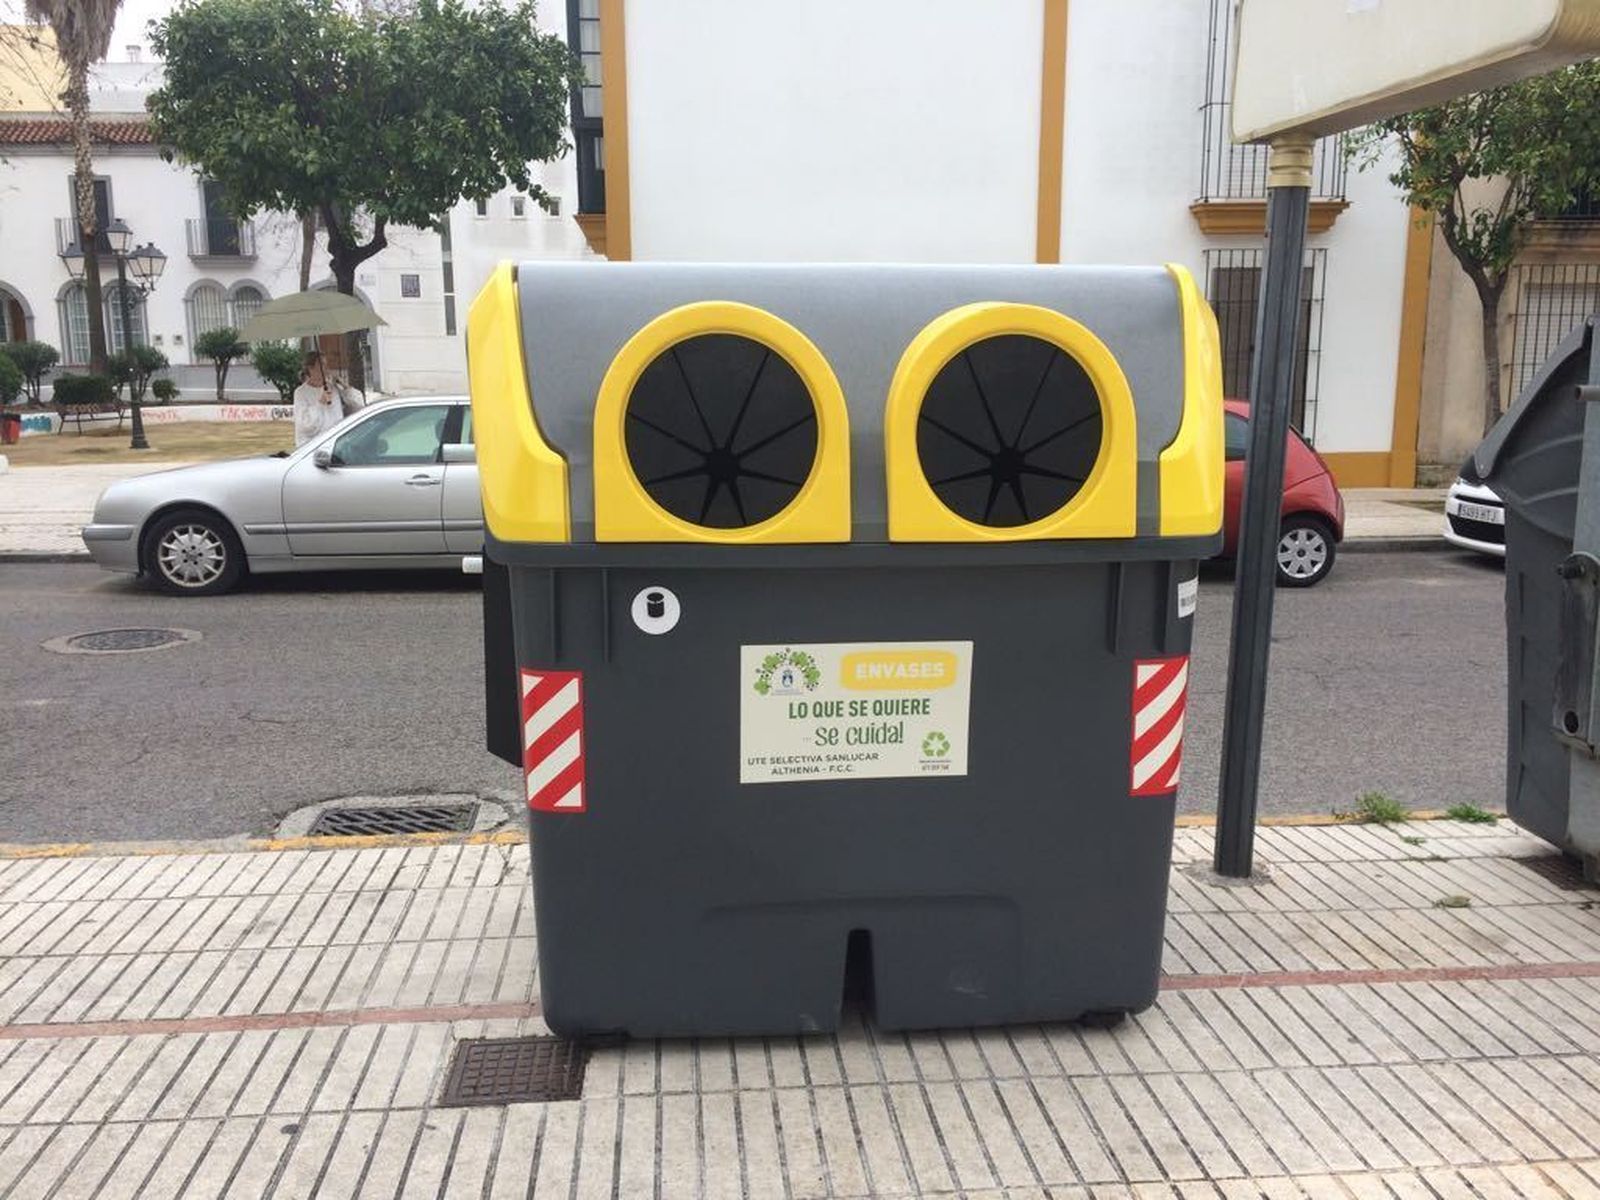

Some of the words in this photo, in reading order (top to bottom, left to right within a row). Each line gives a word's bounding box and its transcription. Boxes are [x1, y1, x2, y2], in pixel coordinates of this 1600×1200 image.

[855, 662, 945, 679] ENVASES
[789, 702, 808, 719] LO
[812, 701, 844, 718] QUE
[849, 700, 868, 717] SE
[872, 698, 931, 716] QUIERE
[846, 721, 905, 746] cuida!
[748, 756, 767, 766] UTE
[769, 754, 823, 765] SELECTIVA
[825, 752, 879, 763] SANLUCAR
[771, 765, 820, 776] ALTHENIA
